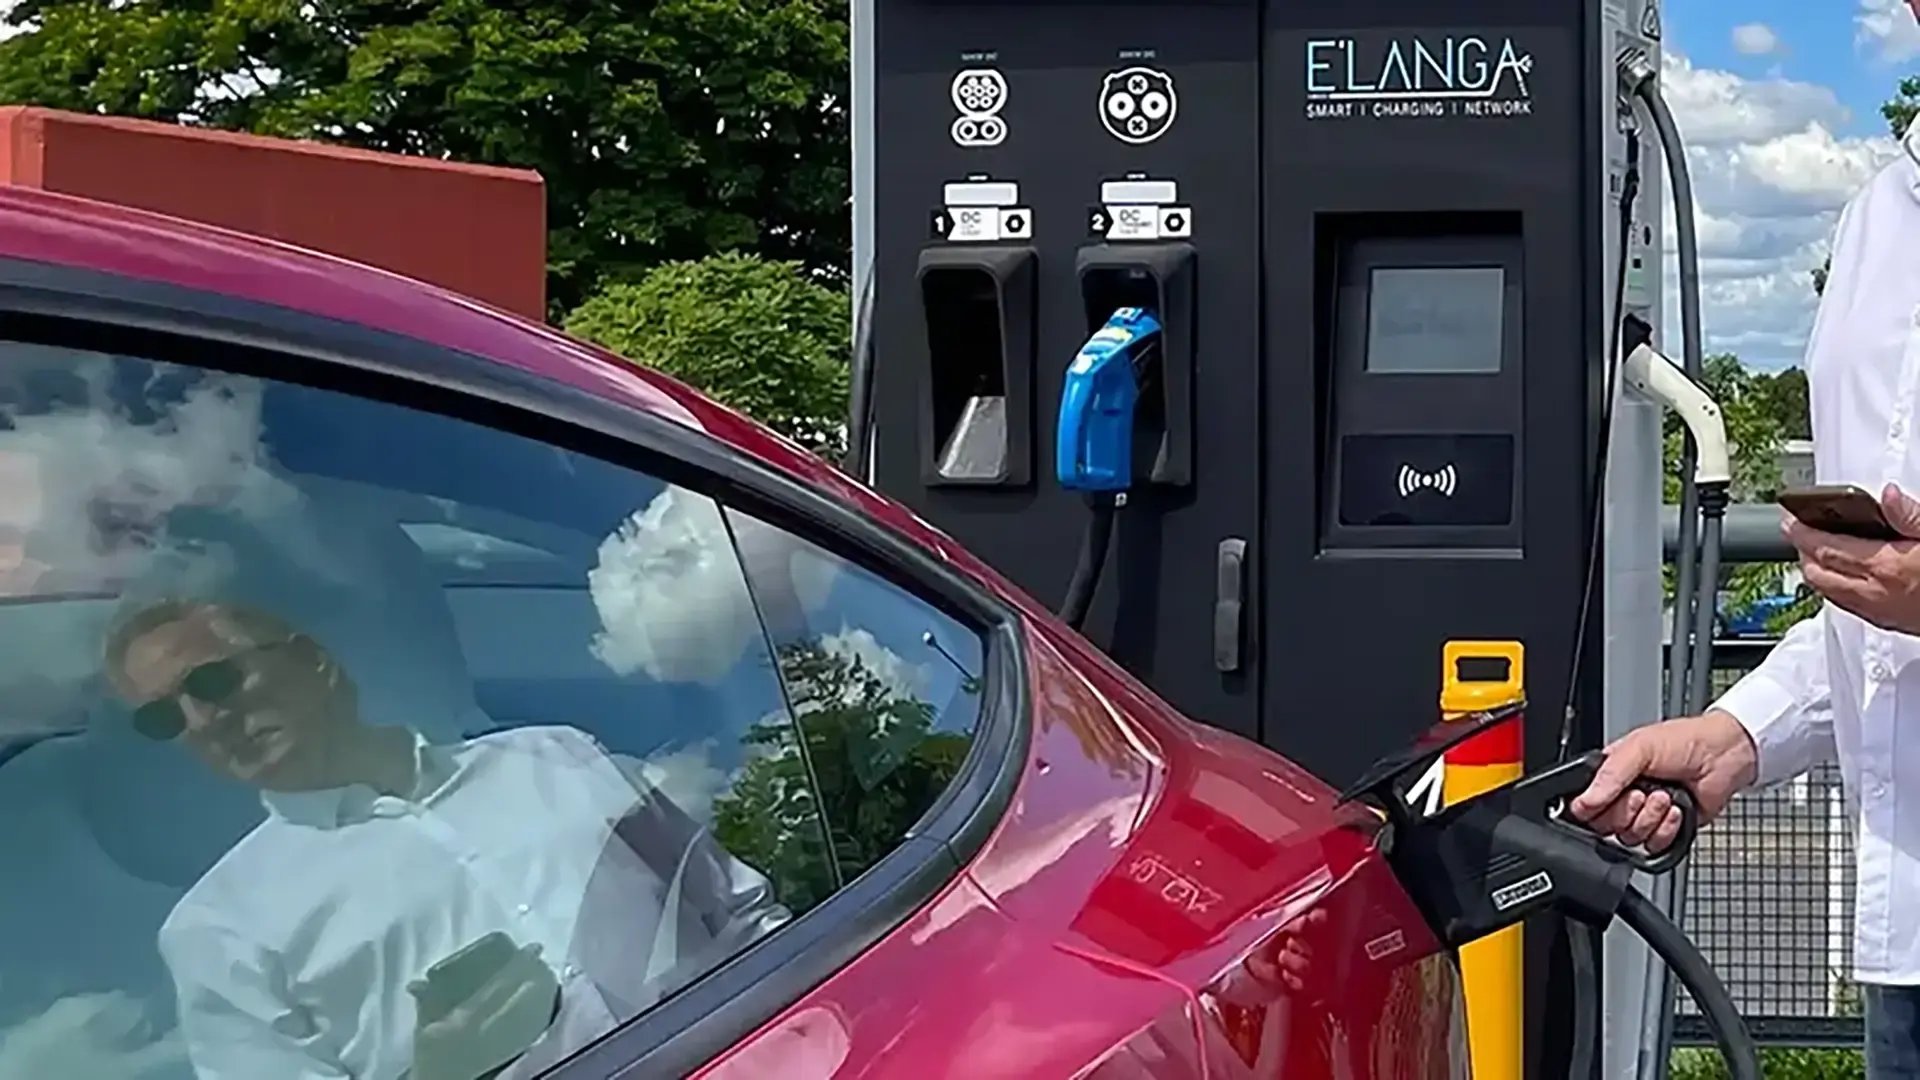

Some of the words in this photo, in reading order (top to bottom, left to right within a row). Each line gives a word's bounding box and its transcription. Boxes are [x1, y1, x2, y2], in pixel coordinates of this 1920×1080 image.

[1306, 102, 1352, 118] SMART
[1372, 101, 1443, 117] CHARGING
[1464, 100, 1533, 116] NETWORK
[935, 215, 945, 233] 1
[960, 211, 982, 224] DC
[1092, 213, 1105, 231] 2
[1119, 209, 1141, 223] DC
